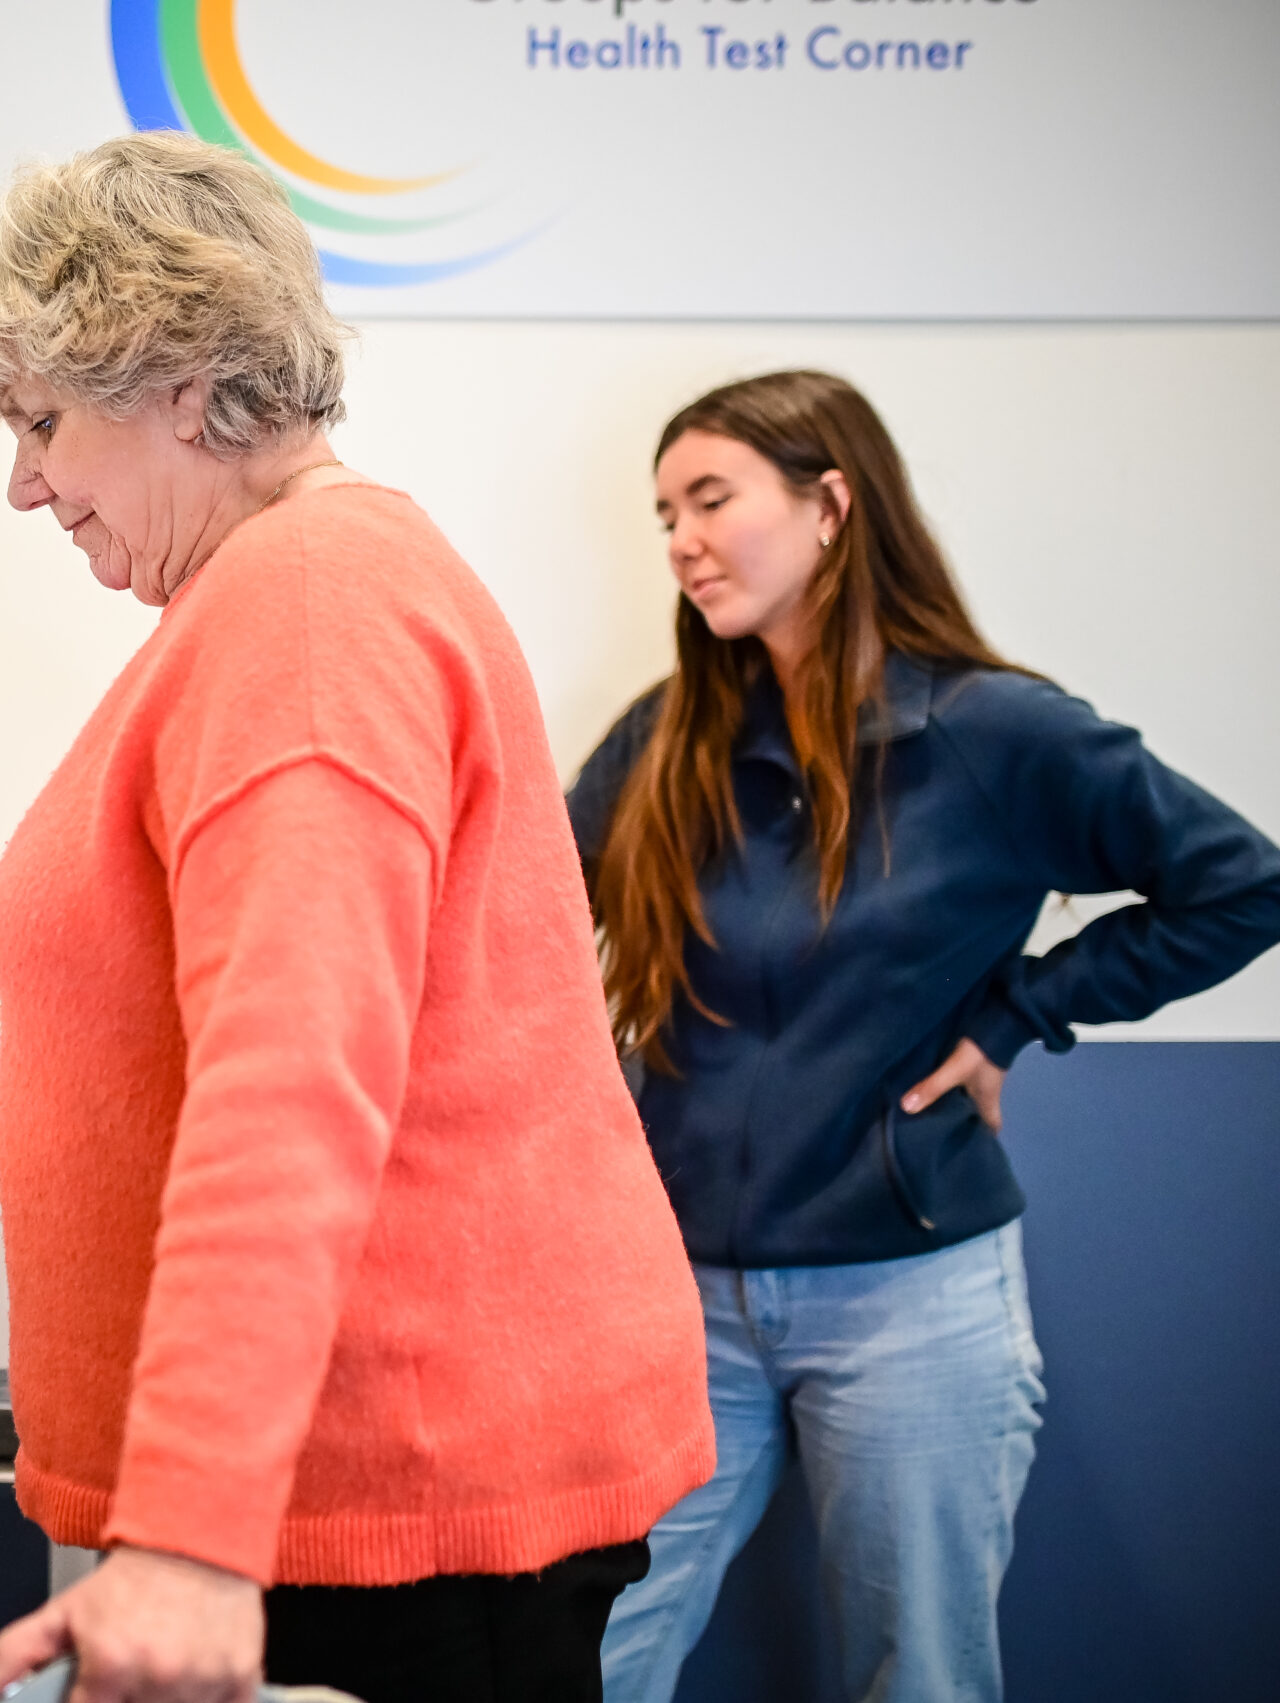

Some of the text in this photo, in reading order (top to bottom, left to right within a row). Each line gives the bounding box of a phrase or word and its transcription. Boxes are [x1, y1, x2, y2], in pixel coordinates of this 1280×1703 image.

[526, 22, 973, 70] Health Test Corner
